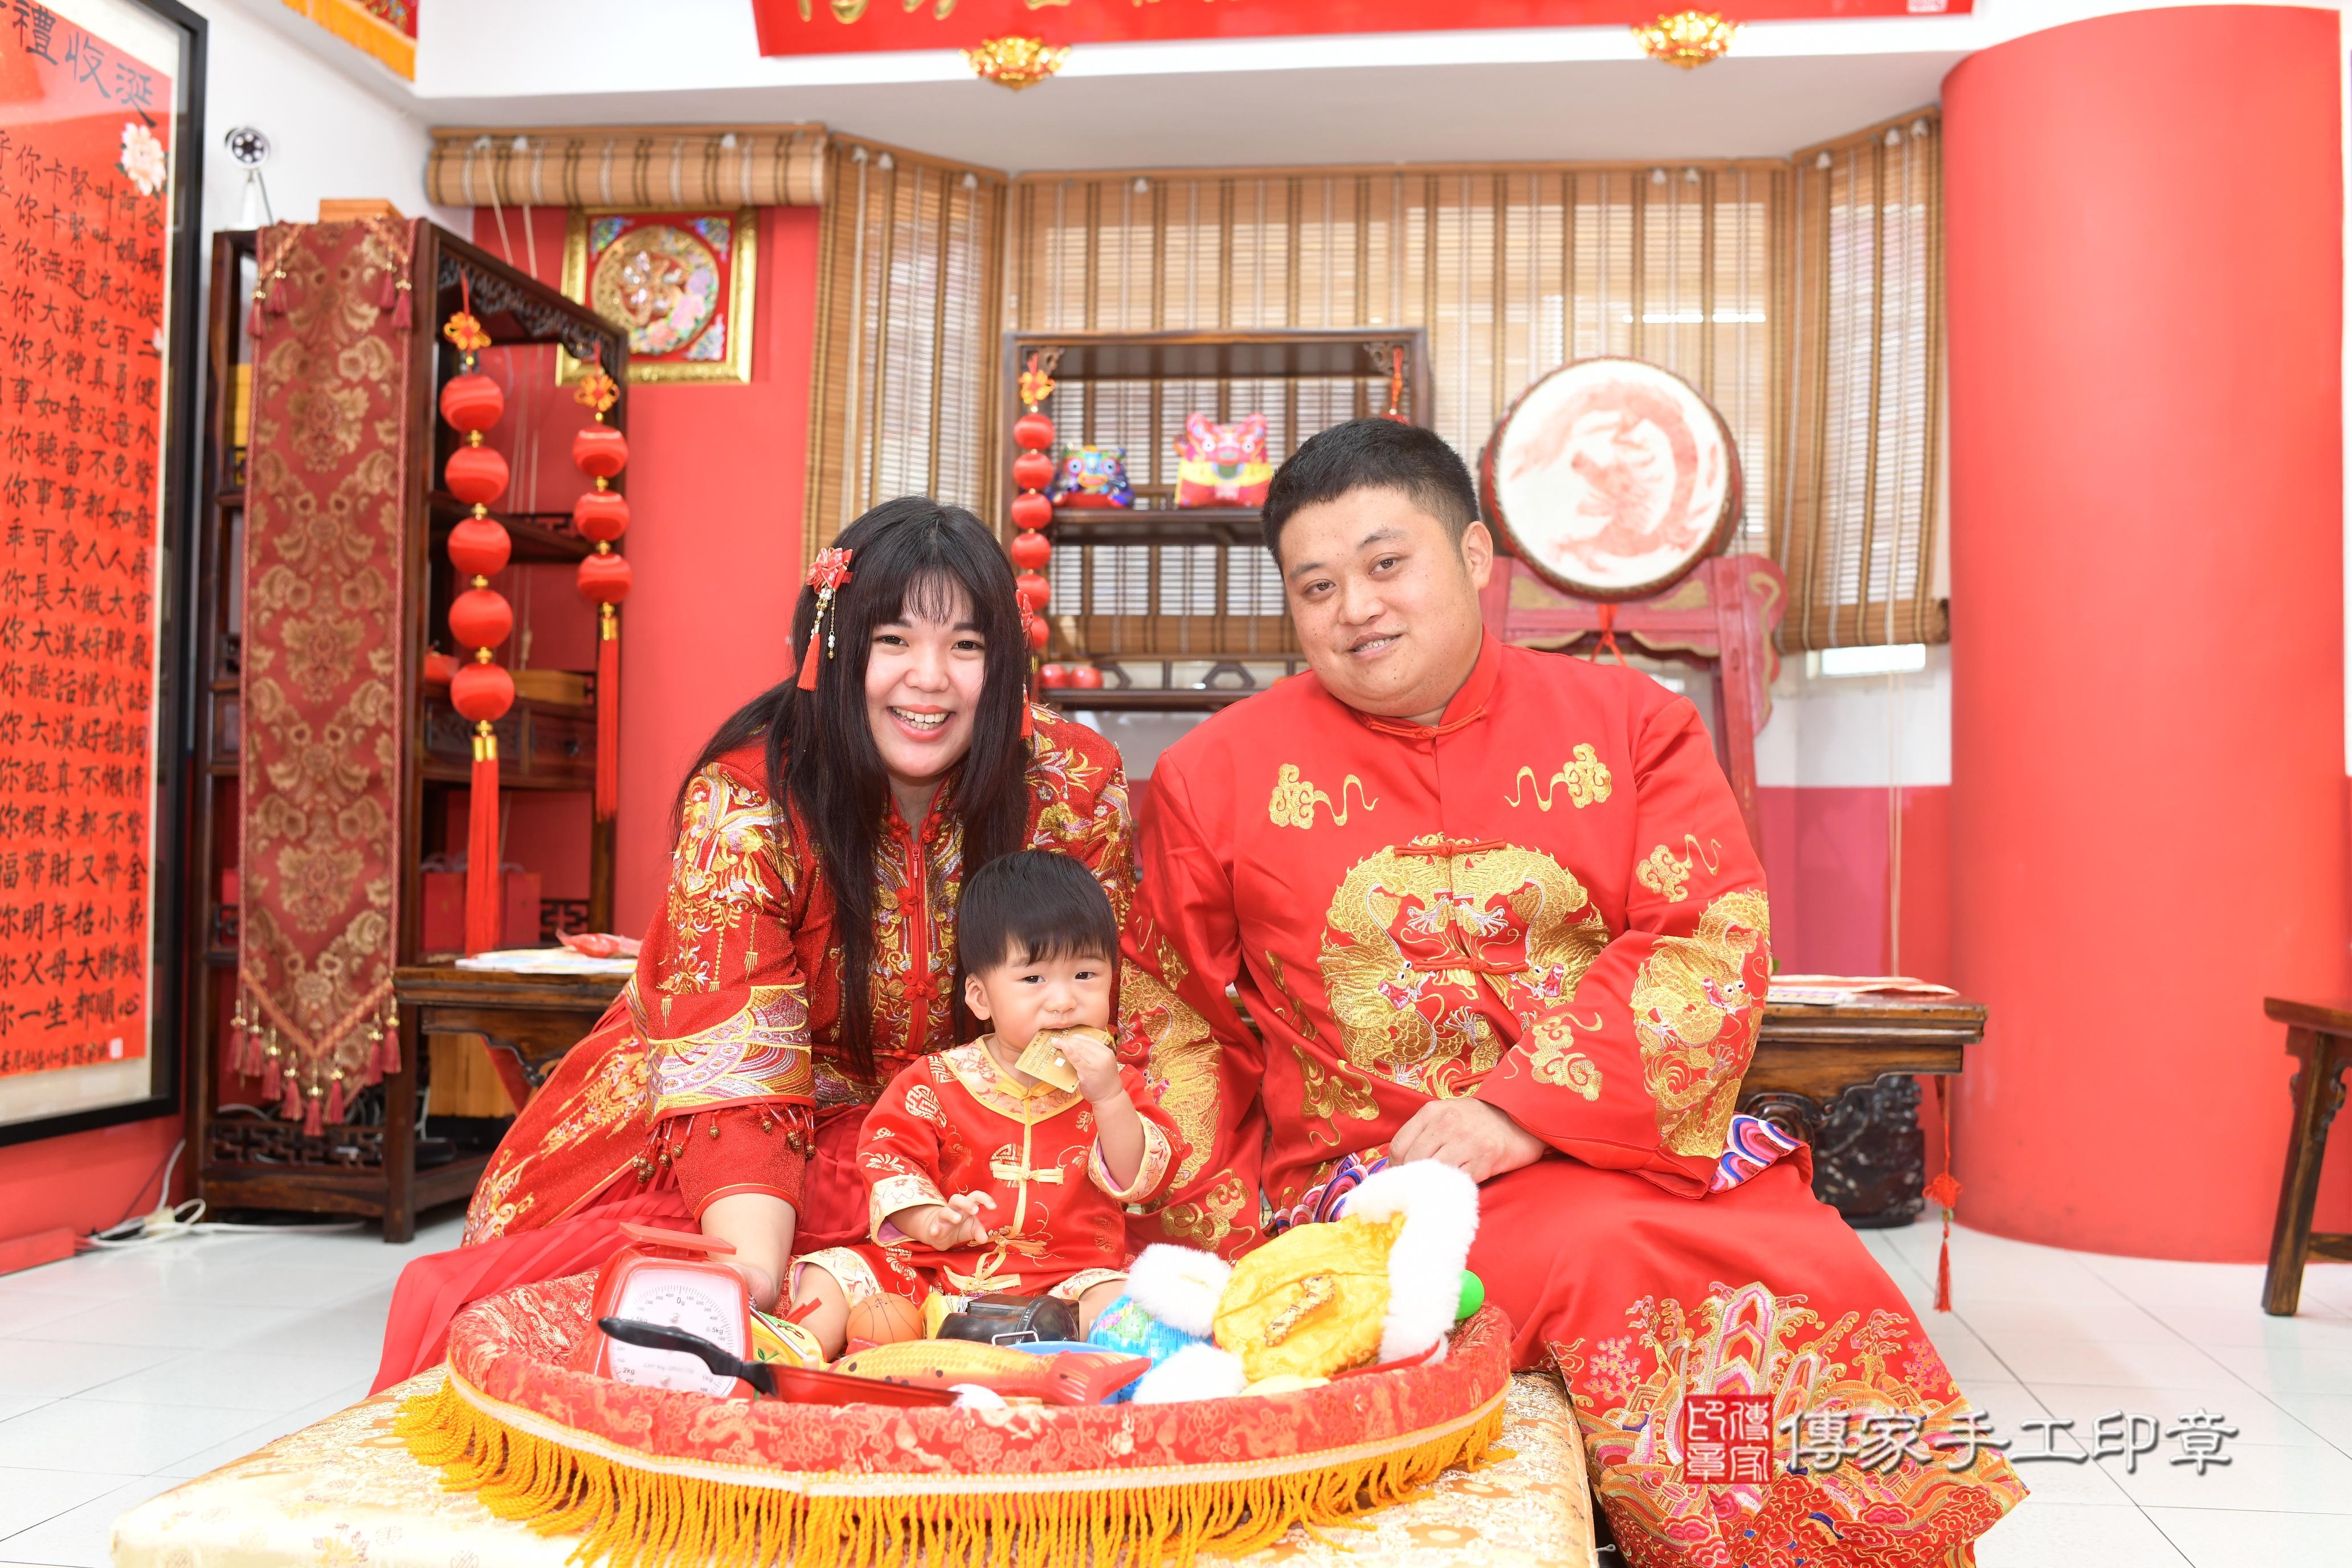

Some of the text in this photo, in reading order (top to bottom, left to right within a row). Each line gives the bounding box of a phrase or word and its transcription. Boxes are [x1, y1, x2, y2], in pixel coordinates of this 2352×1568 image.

[0, 0, 156, 127] 禮收涎
[0, 224, 162, 326] 你嘸通流水涎
[0, 280, 161, 359] 你大漢吃百二
[0, 325, 157, 412] 你身體真勇健
